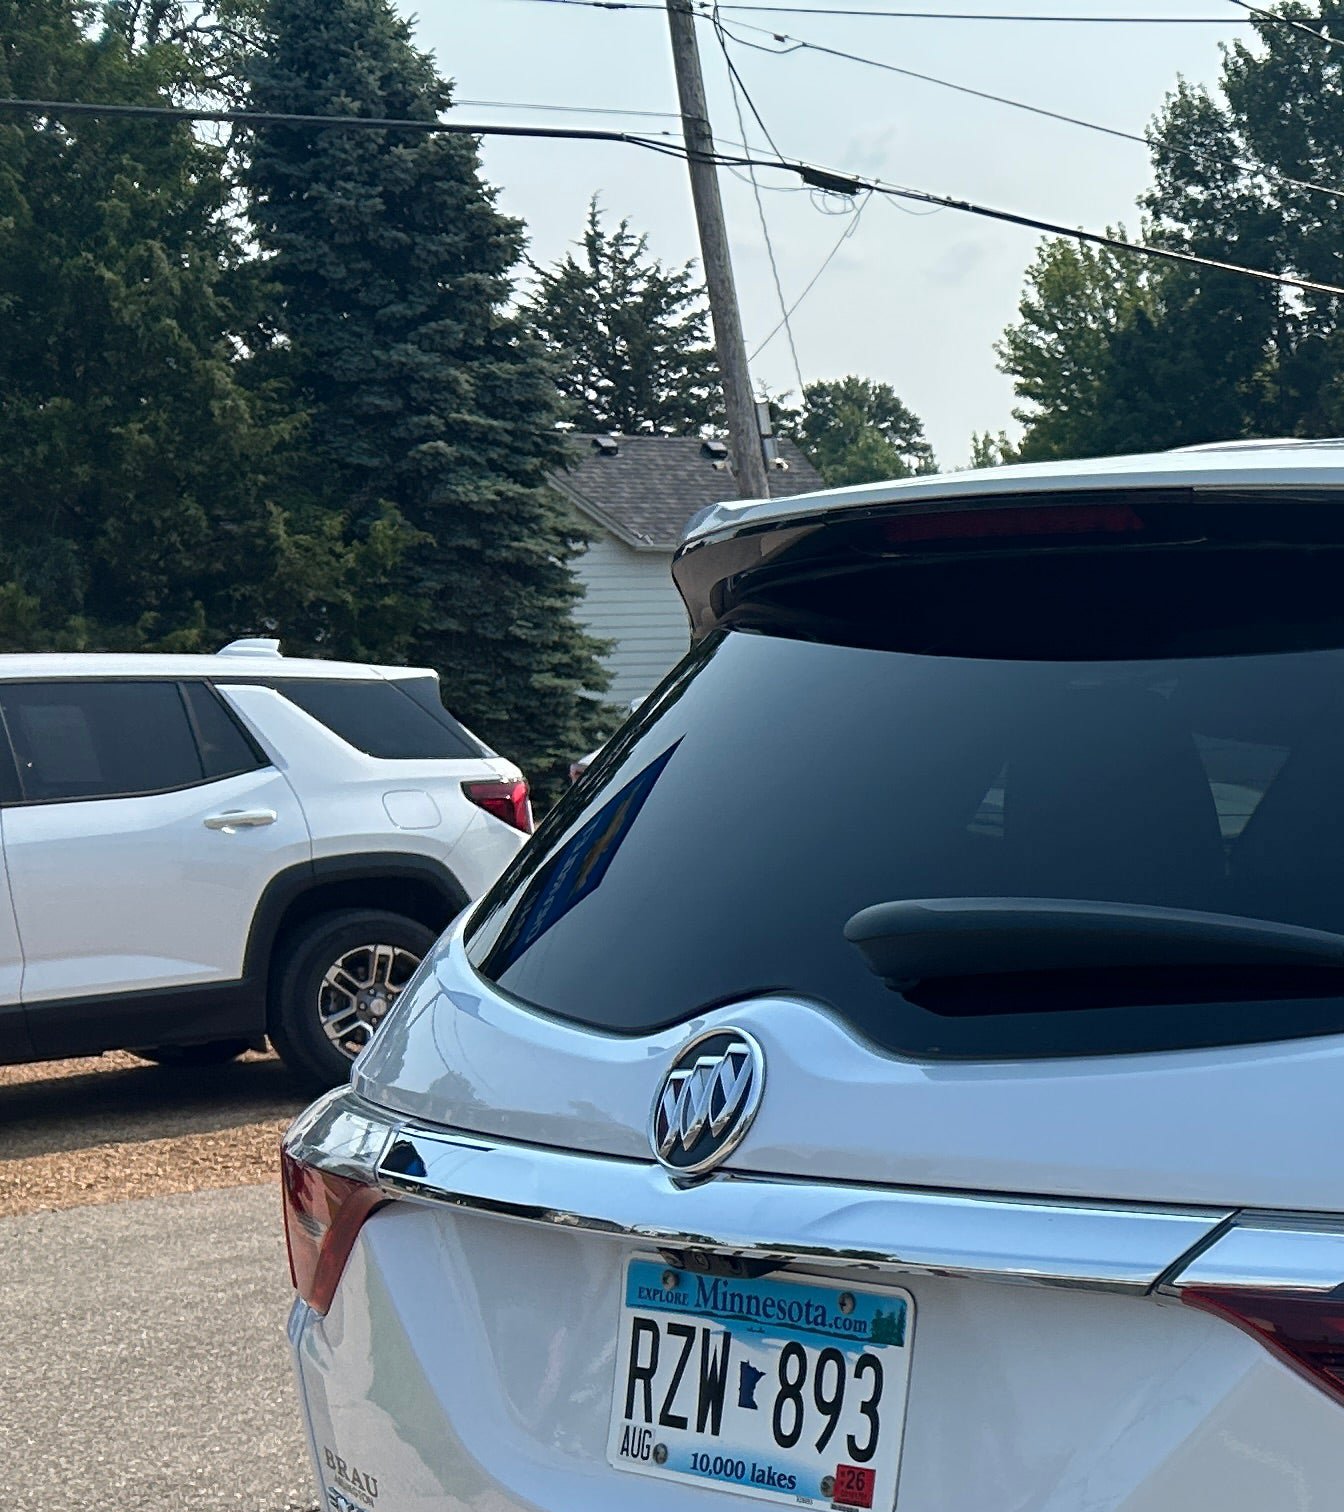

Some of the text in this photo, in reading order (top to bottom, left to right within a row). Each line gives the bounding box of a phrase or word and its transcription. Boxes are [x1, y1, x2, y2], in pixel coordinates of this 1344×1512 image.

[637, 1285, 689, 1306] EXPLORE
[624, 1316, 884, 1463] RZW 893
[619, 1425, 653, 1461] AUG
[324, 1446, 379, 1498] BRAU
[690, 1452, 797, 1490] 10,000 lakes
[845, 1470, 866, 1492] 26
